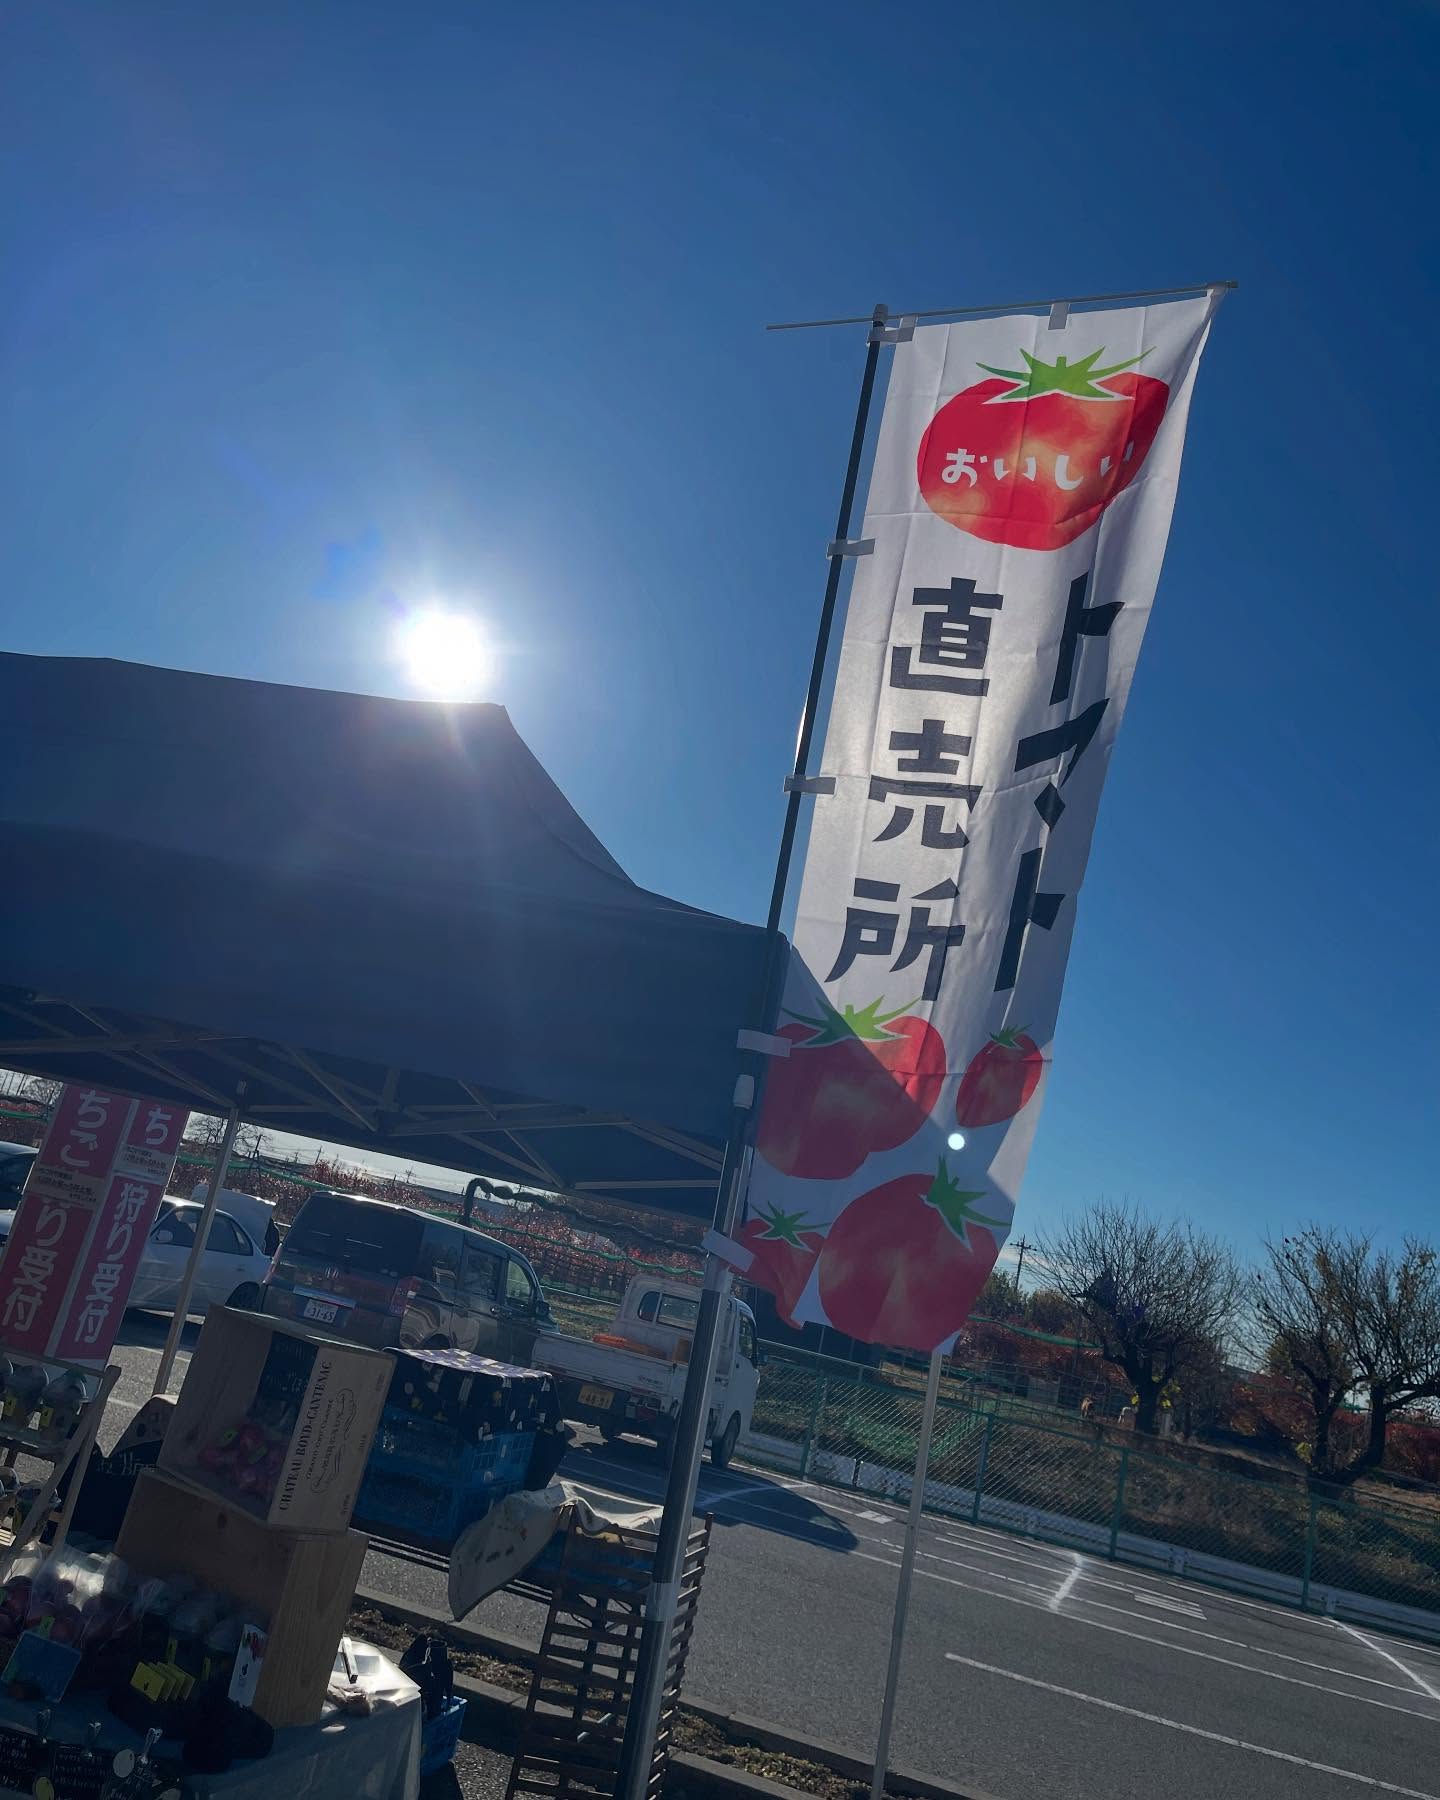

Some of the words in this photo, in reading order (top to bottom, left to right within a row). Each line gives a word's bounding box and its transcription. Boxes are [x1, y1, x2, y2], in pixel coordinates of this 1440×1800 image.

[941, 441, 1134, 489] おいしい
[824, 576, 1004, 1001] 直売所
[994, 571, 1126, 993] トマト
[310, 1307, 335, 1321] 31-65
